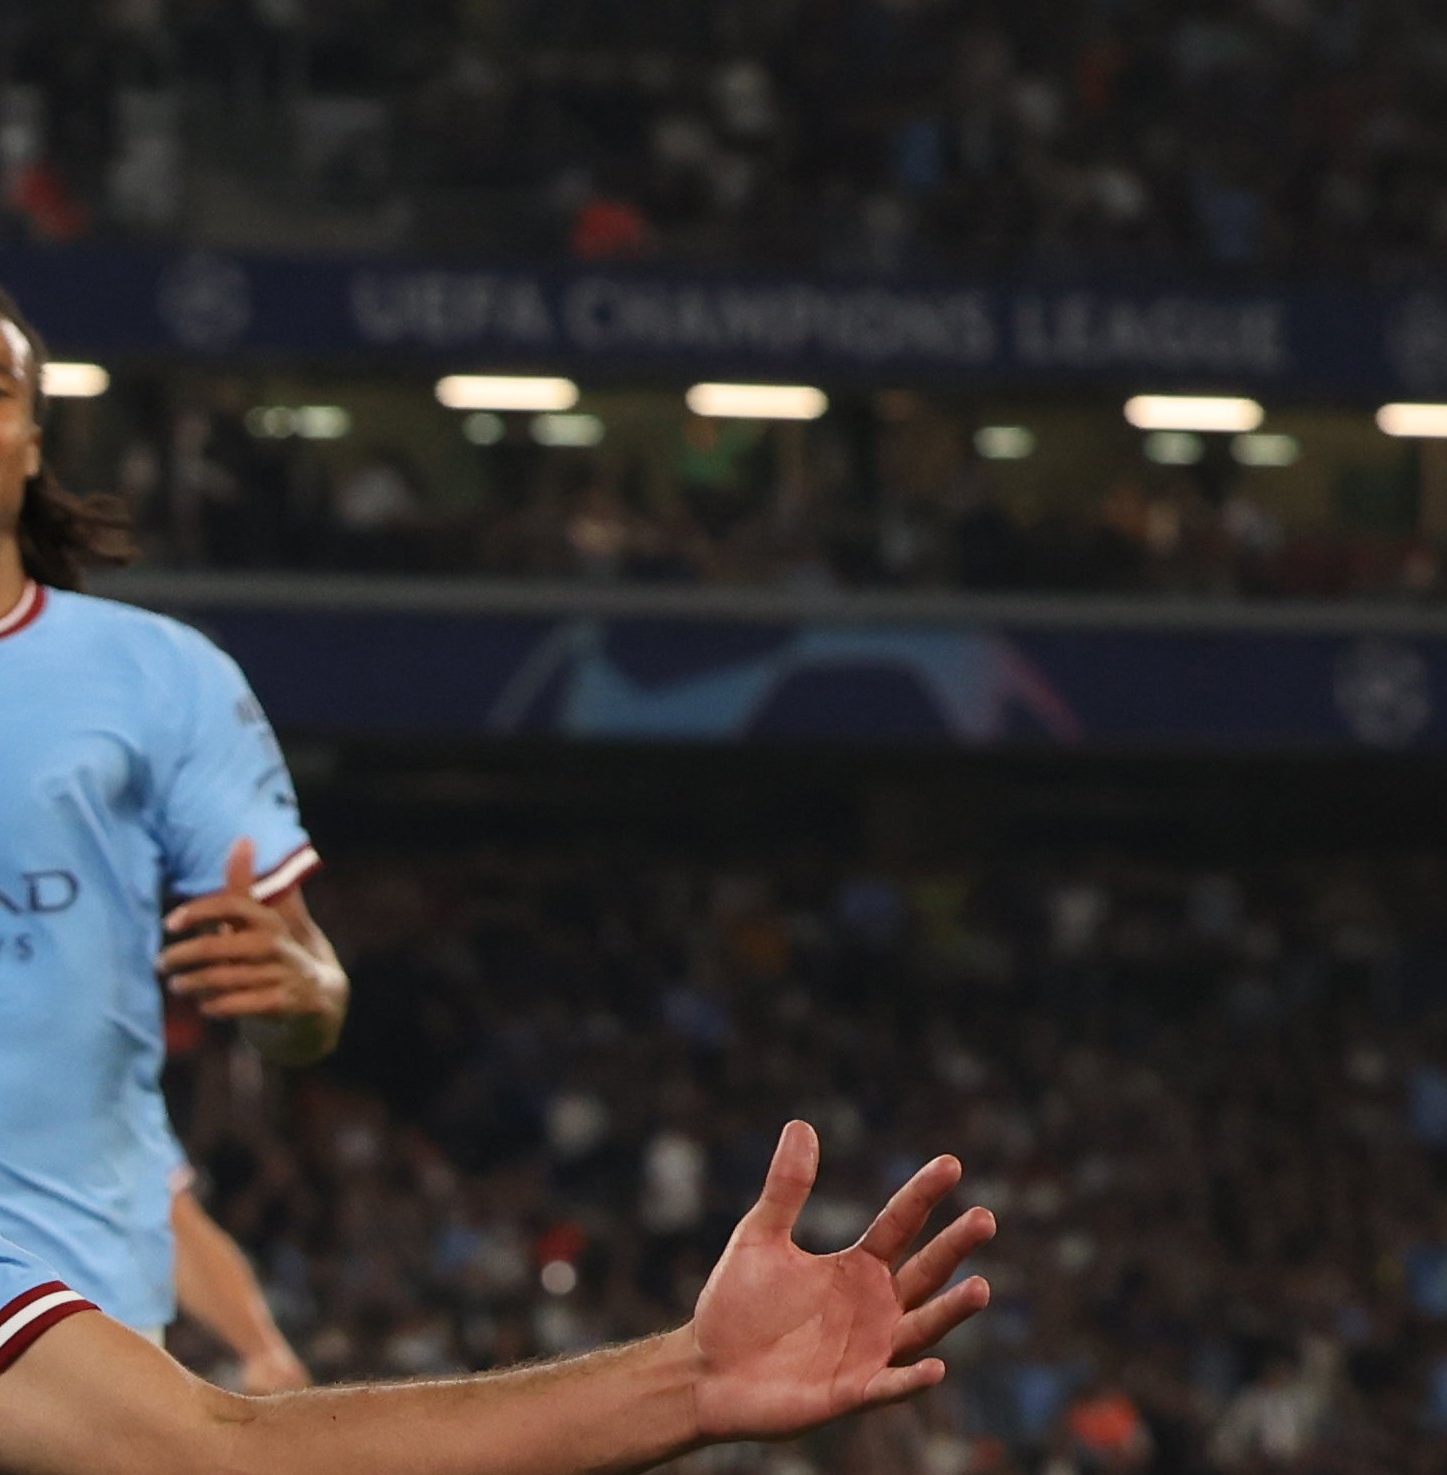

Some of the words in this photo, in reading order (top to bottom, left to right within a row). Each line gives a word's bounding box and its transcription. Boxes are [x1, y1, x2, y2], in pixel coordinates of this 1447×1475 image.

[349, 270, 553, 347] UEFA
[563, 276, 994, 362] CHAMPIONS
[1010, 289, 1288, 373] LEAGUE
